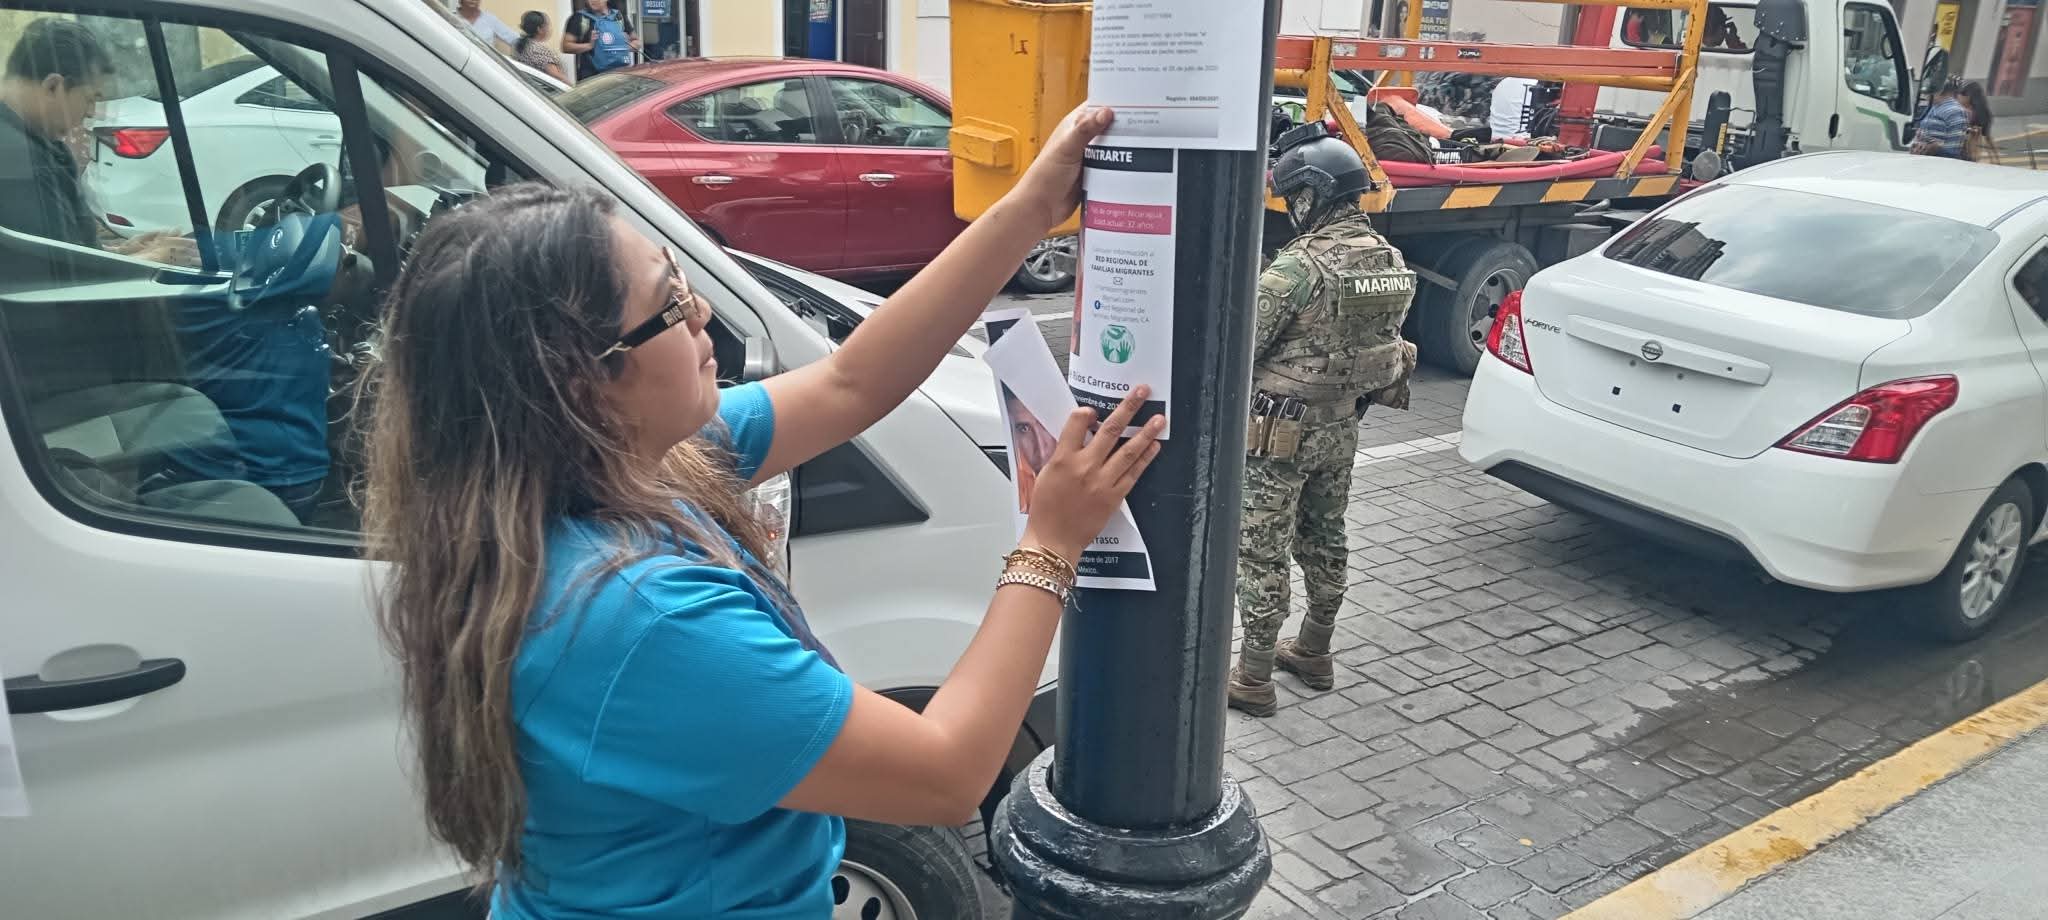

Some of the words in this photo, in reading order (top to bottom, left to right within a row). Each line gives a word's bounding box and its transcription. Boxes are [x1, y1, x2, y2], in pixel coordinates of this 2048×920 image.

[1106, 256, 1137, 266] REGIONAL
[1138, 258, 1148, 267] DE
[1090, 263, 1114, 274] FAMILIAS
[1115, 267, 1154, 276] MIGRANTES
[1355, 277, 1411, 293] MARINA
[1087, 375, 1130, 391] Carrasco
